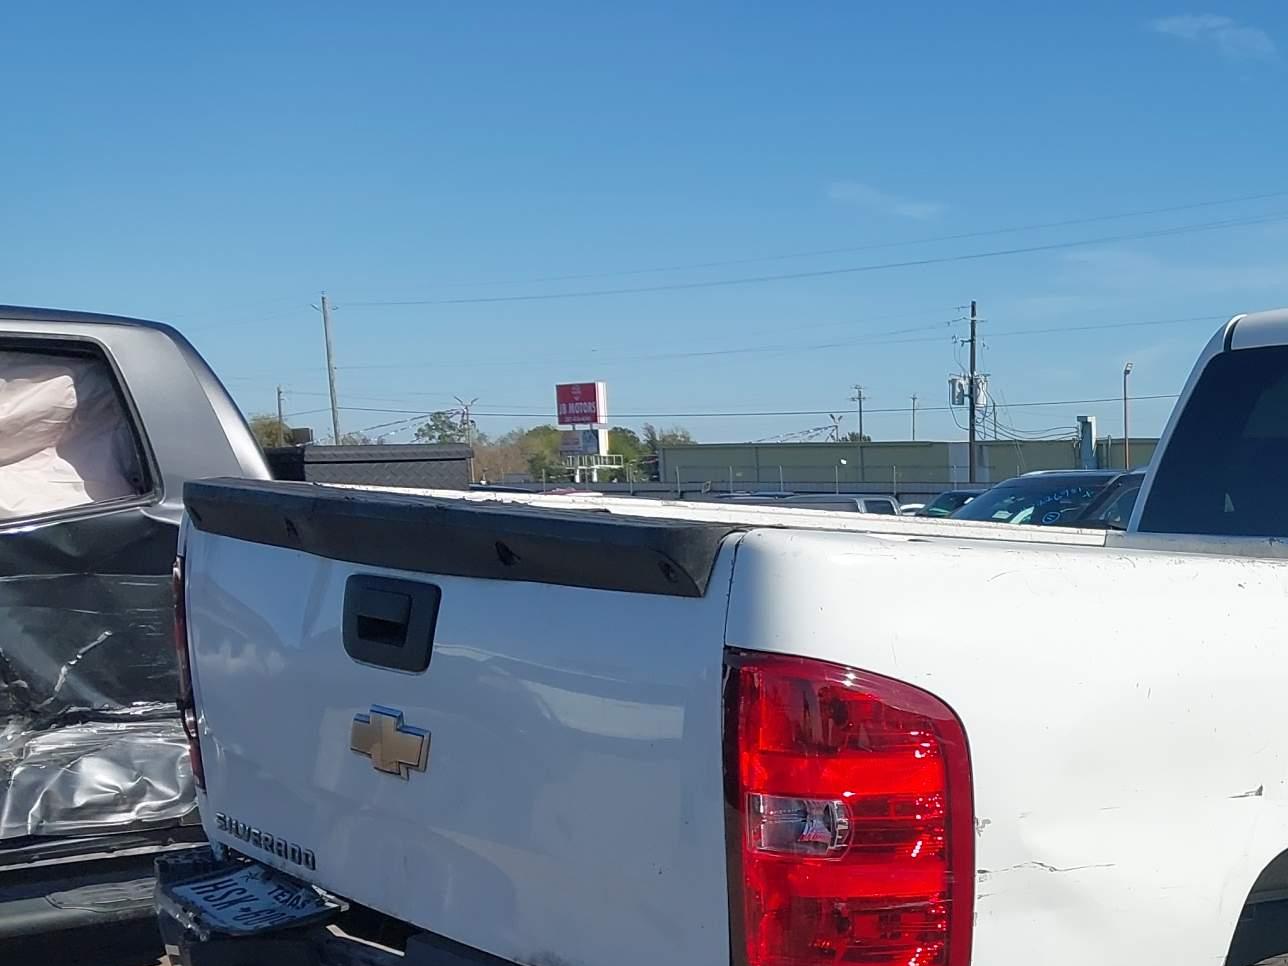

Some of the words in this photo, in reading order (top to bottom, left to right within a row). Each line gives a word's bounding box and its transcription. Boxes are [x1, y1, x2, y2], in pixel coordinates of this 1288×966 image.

[568, 401, 596, 414] MOTORS
[215, 811, 317, 871] SILVERADO
[267, 884, 312, 911] TEXAS
